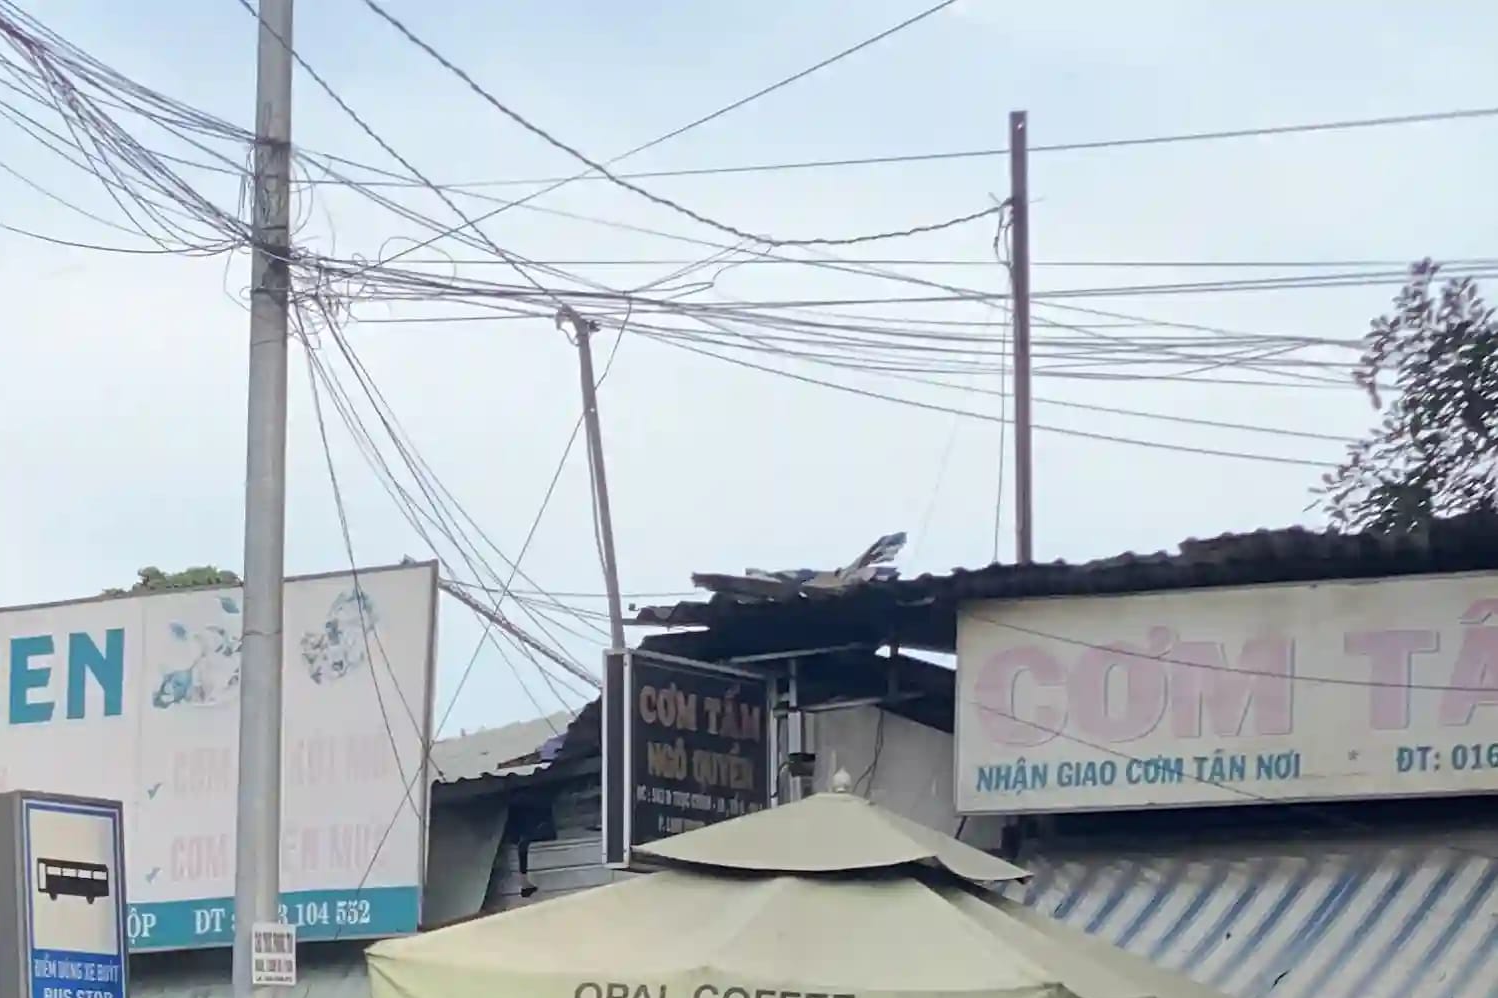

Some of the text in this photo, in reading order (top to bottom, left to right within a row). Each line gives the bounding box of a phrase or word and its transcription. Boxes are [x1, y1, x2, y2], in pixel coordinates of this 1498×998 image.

[974, 625, 1297, 748] CƠM
[976, 757, 1048, 797] NHẬN
[1057, 759, 1117, 789] GIAO
[1125, 753, 1184, 785] CƠM
[1256, 749, 1302, 781] NƠI
[295, 899, 329, 927] 104
